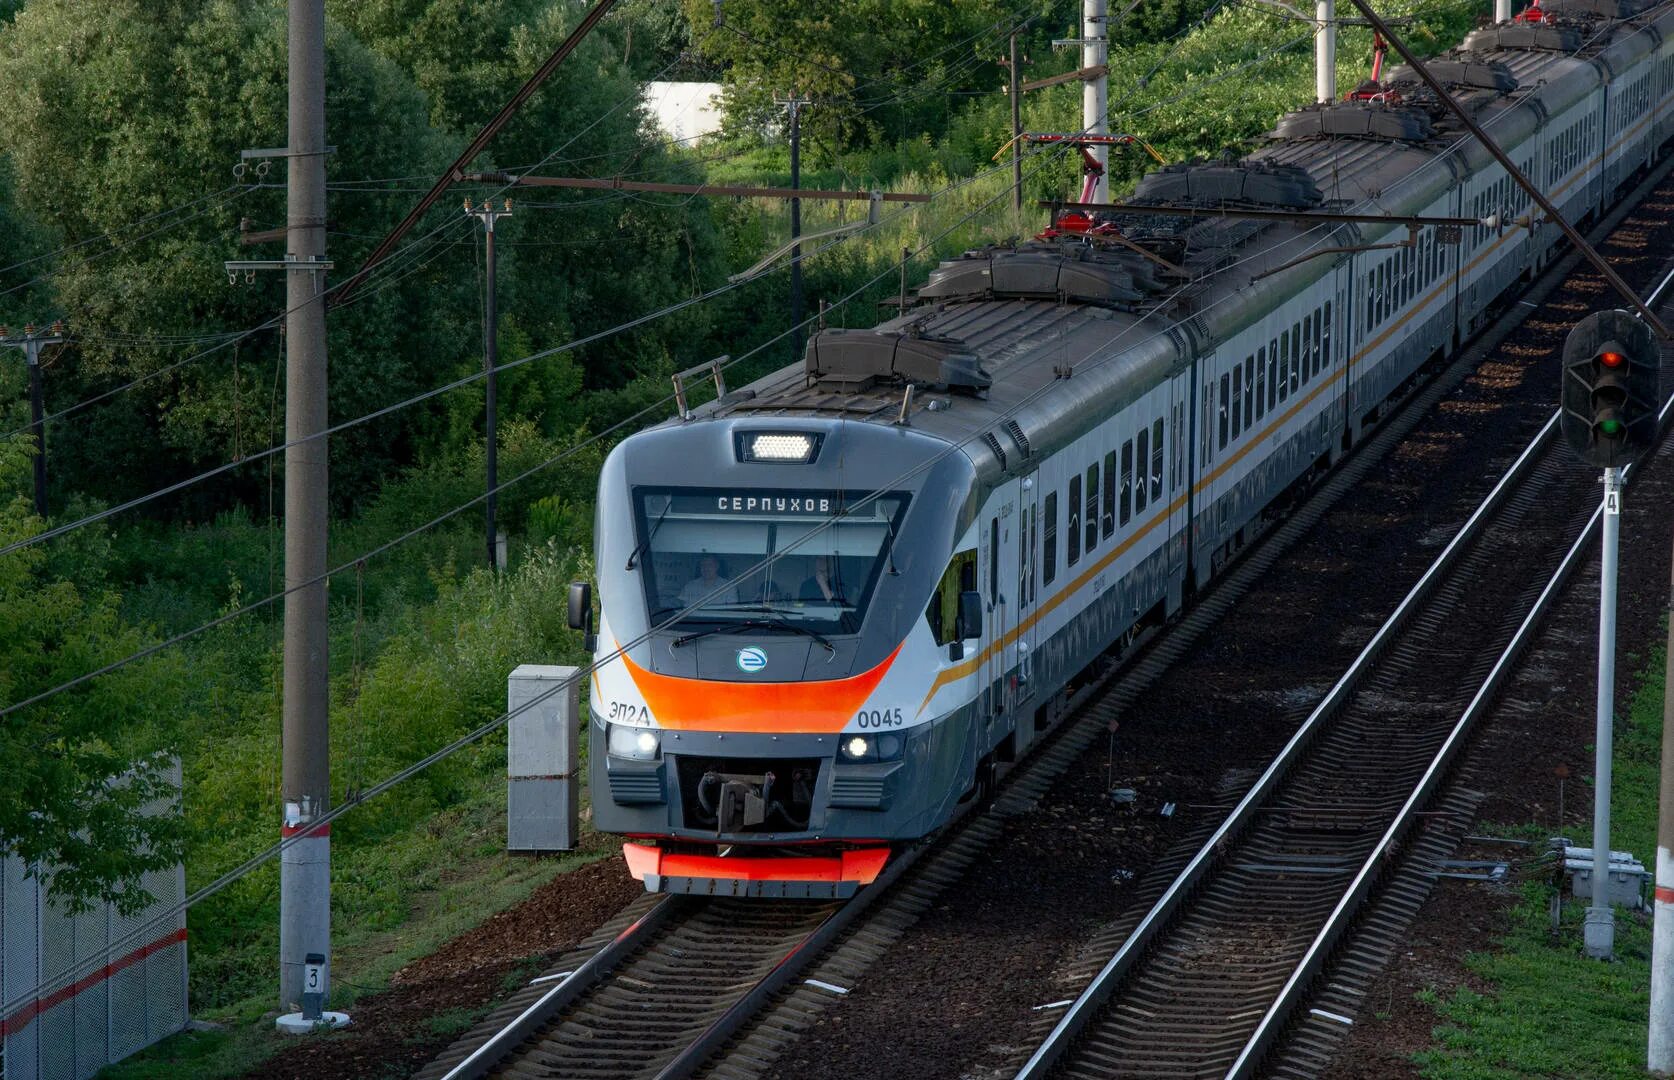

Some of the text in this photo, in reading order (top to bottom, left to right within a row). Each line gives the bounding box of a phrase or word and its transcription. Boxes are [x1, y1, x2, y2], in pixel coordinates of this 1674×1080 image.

[718, 497, 829, 512] СЕРПУХОВ
[609, 701, 650, 726] ЭП2Д
[857, 707, 903, 729] 0045
[309, 968, 318, 988] 3
